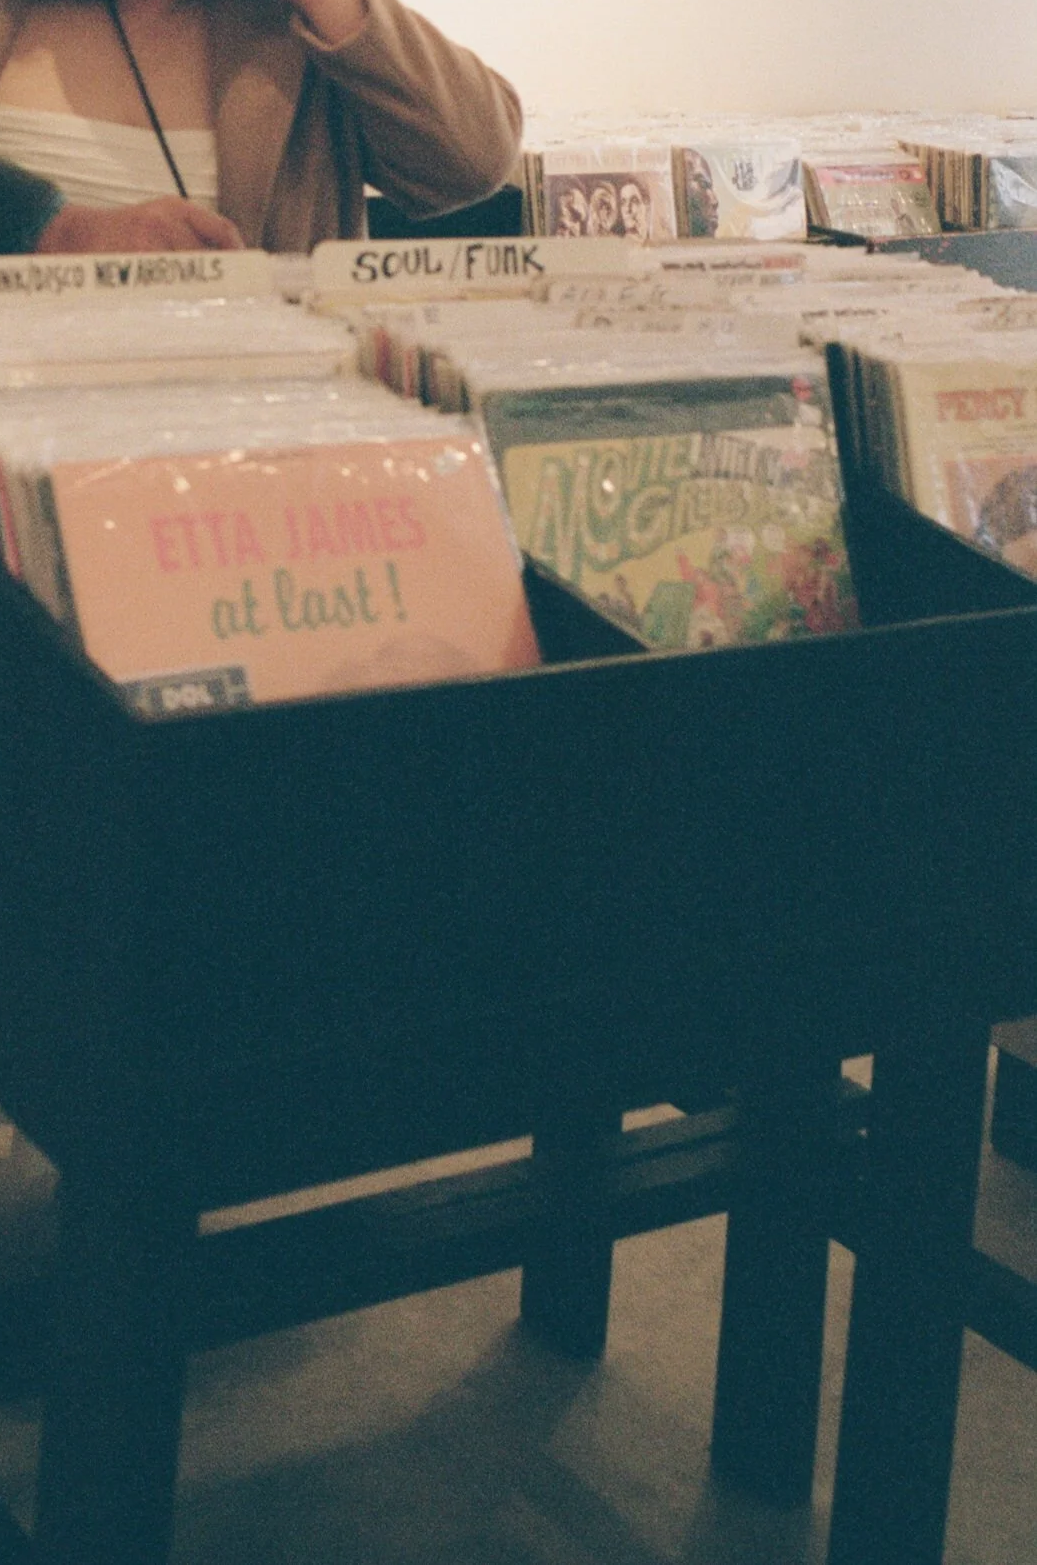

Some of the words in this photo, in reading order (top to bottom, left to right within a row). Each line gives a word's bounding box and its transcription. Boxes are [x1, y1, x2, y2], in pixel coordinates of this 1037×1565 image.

[94, 259, 132, 287] NEW
[149, 508, 267, 573] ETTA
[282, 495, 429, 564] JAMES
[210, 578, 266, 641] at
